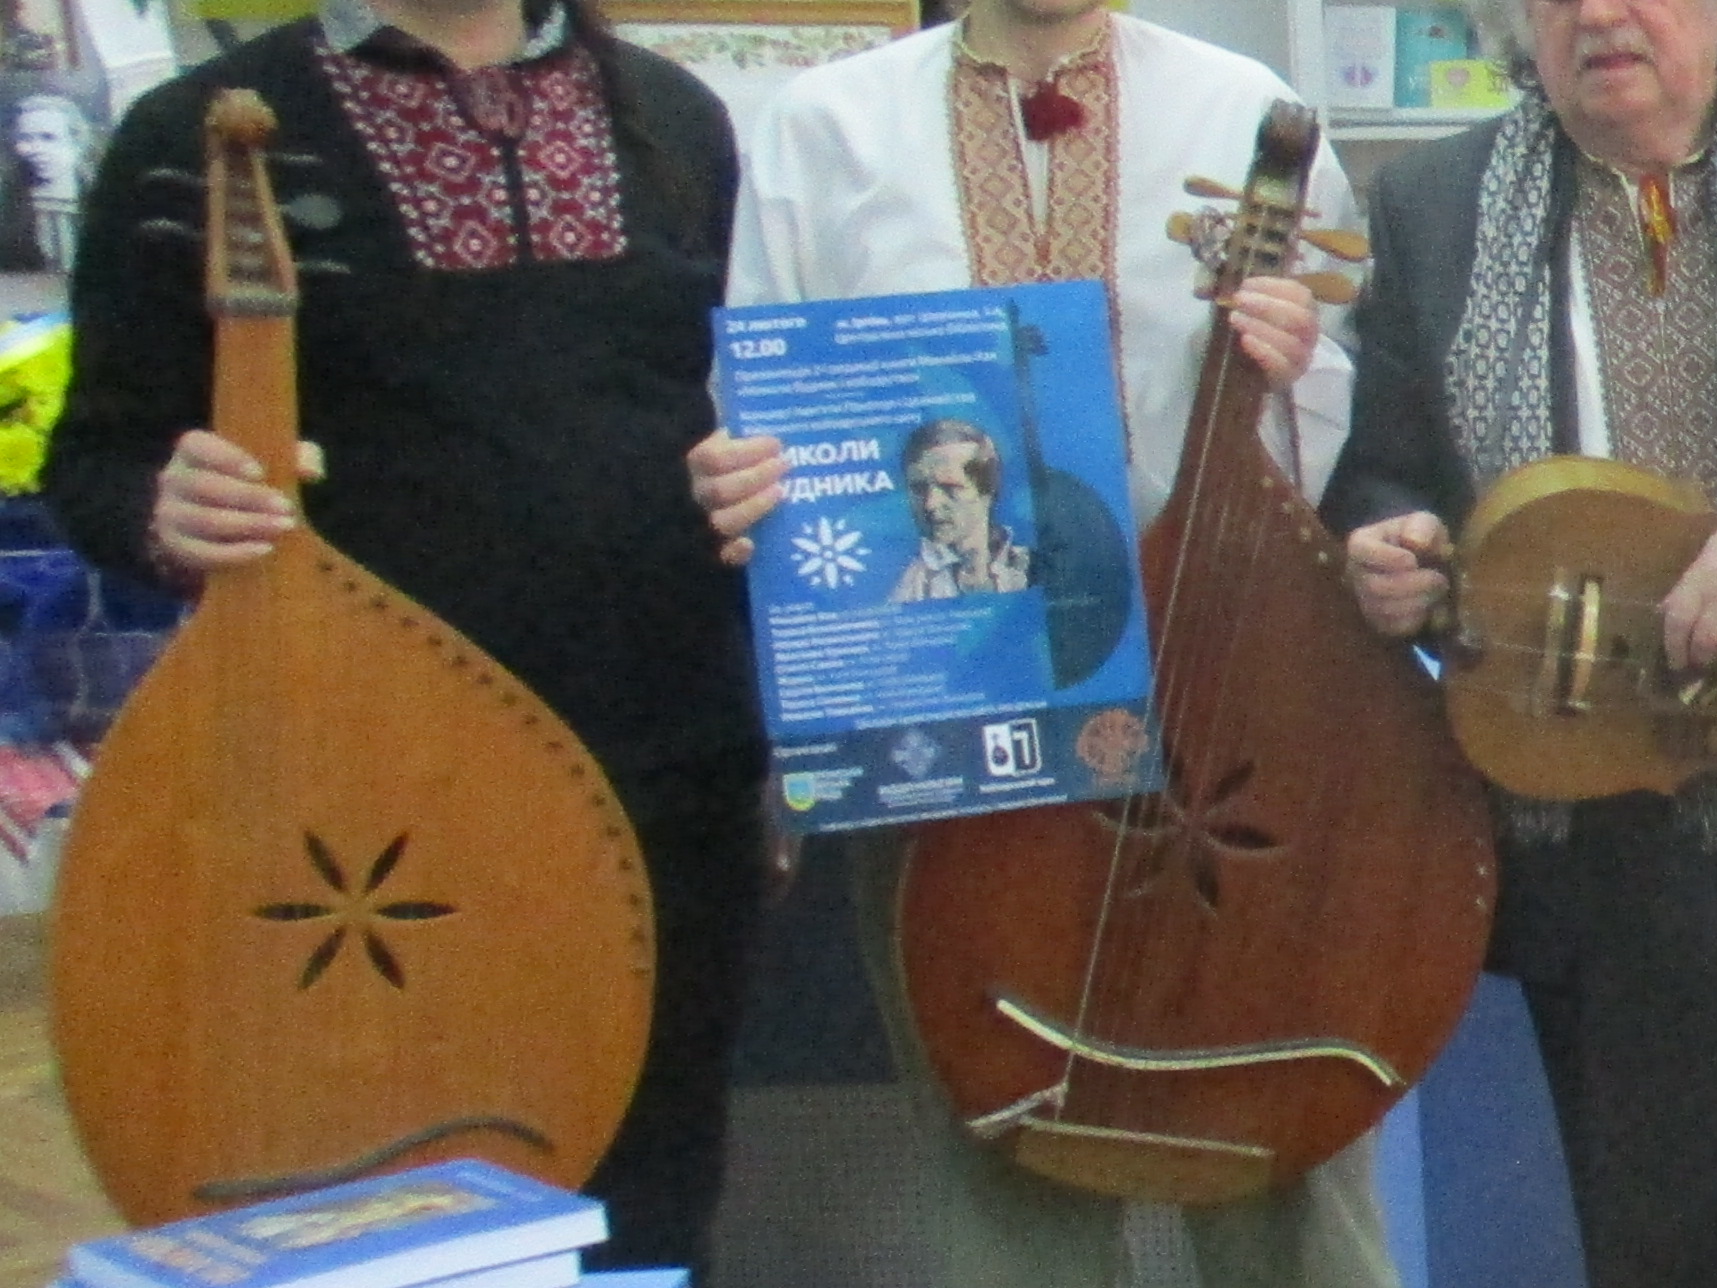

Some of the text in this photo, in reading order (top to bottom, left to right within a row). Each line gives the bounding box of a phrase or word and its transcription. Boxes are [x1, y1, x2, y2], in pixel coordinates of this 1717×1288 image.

[729, 338, 787, 359] 12.00
[782, 438, 881, 467] ИКОЛИ
[781, 470, 895, 503] УДНИКА
